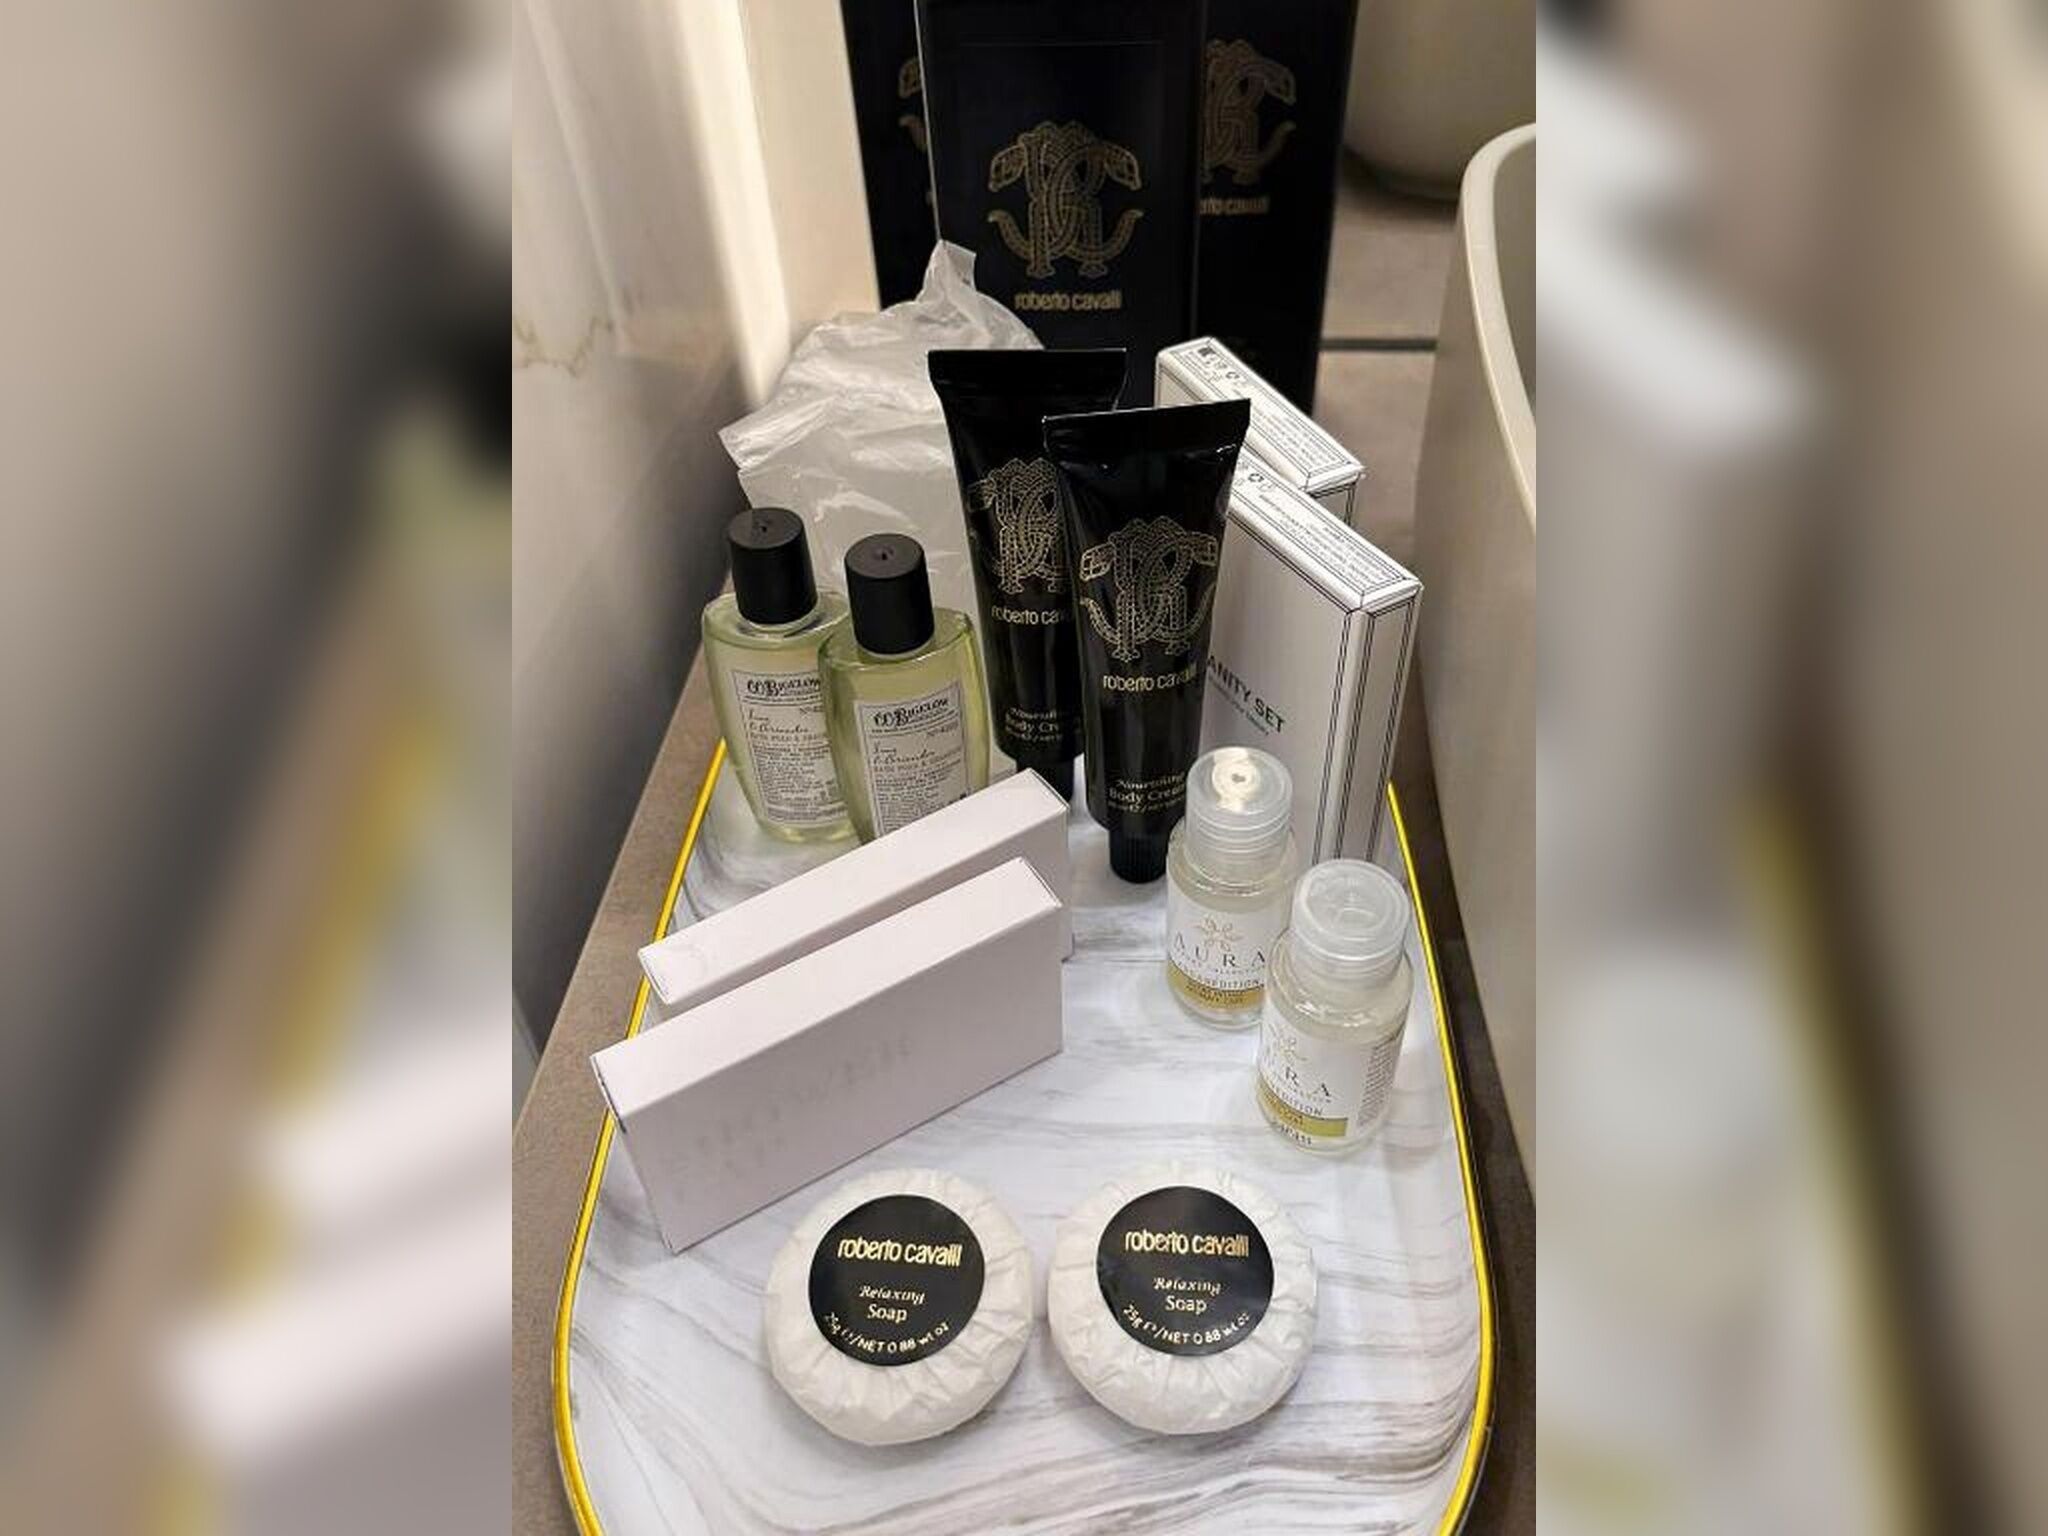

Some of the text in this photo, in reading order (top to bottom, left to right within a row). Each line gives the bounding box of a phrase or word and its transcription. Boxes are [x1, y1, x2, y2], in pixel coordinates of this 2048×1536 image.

[1015, 289, 1121, 311] roberto cavalli
[1103, 674, 1154, 692] roberto
[1206, 655, 1251, 702] ANITY
[1254, 698, 1285, 733] SET
[1109, 787, 1144, 804] Body
[1173, 931, 1266, 968] AURA
[838, 1236, 963, 1267] roberto cavalli
[1124, 1229, 1249, 1257] roberto cavalli
[859, 1285, 926, 1305] Relaxing
[1153, 1277, 1222, 1297] Relaxing
[867, 1303, 908, 1323] Soap
[1165, 1295, 1208, 1315] Soap
